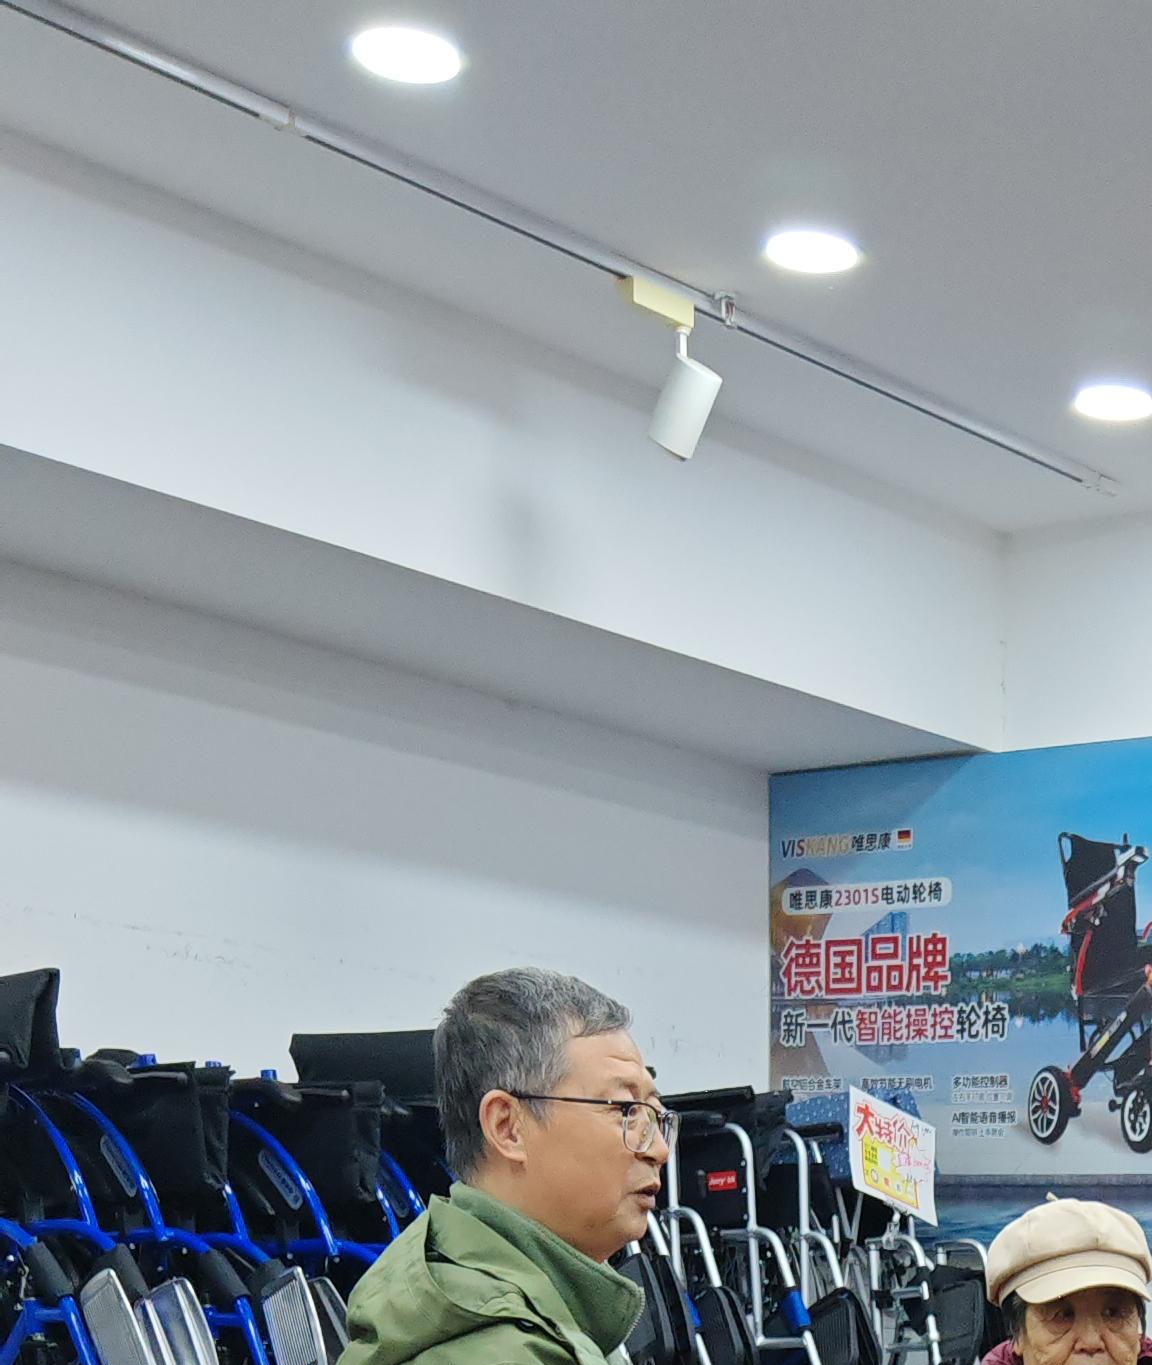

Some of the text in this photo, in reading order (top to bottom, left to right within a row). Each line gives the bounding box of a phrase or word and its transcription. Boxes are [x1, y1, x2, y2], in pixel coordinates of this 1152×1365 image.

[789, 881, 943, 911] 唯思康2301S电动轮椅
[781, 932, 949, 996] 德国品牌
[782, 1004, 1008, 1045] 新一代智能操控轮椅
